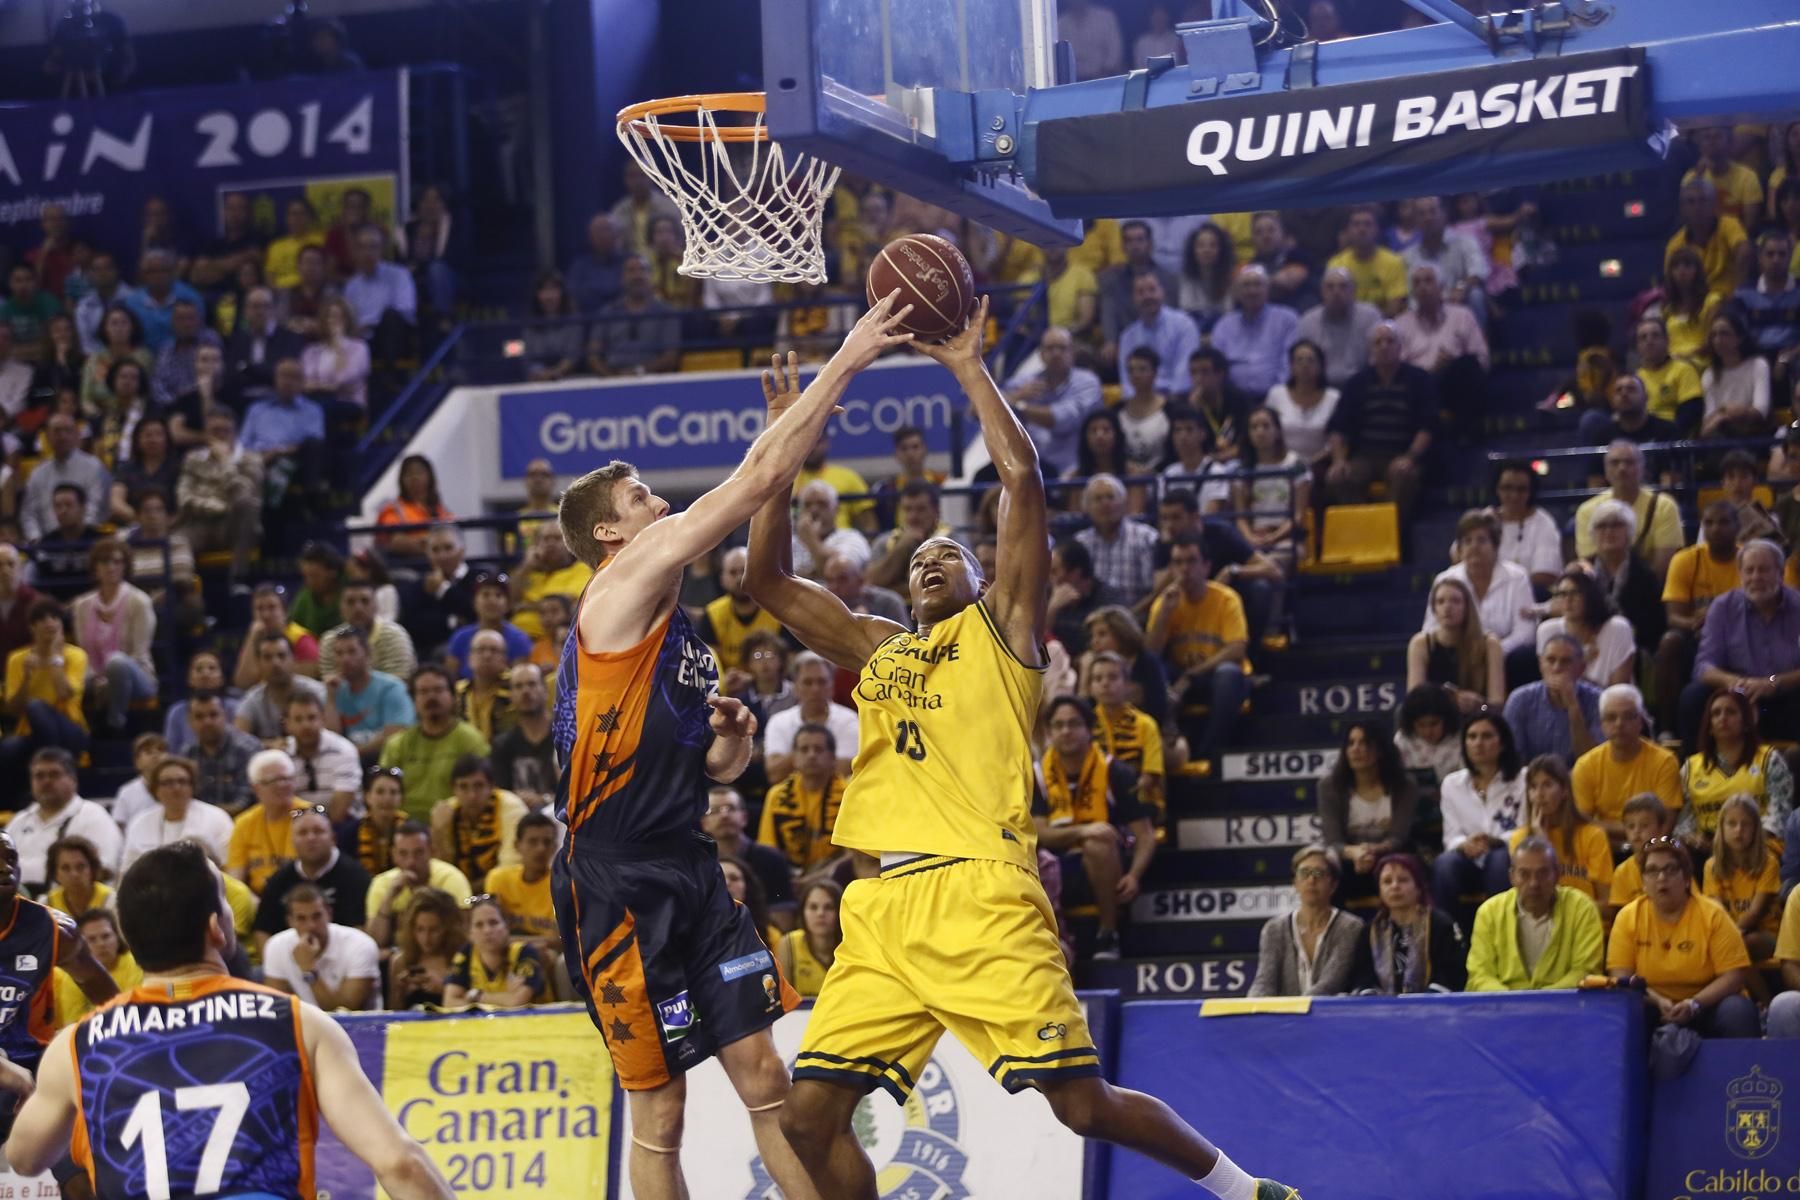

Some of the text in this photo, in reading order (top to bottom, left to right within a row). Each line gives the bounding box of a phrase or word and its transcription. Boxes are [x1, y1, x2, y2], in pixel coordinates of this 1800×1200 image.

[196, 94, 374, 168] 2014
[1187, 66, 1638, 176] QUINI BASKET
[858, 678, 943, 710] Canaria
[872, 657, 926, 691] Gran
[1300, 682, 1397, 715] ROES
[896, 719, 927, 761] 13
[1225, 816, 1324, 844] ROES
[1136, 960, 1246, 994] ROES
[87, 994, 276, 1046] R.MARTINEZ
[428, 1050, 558, 1097] Gran
[397, 1090, 599, 1145] Canaria
[120, 1081, 251, 1200] 17
[912, 1139, 951, 1171] 1916
[447, 1151, 546, 1192] 2014
[1685, 1168, 1781, 1193] Cabildo
